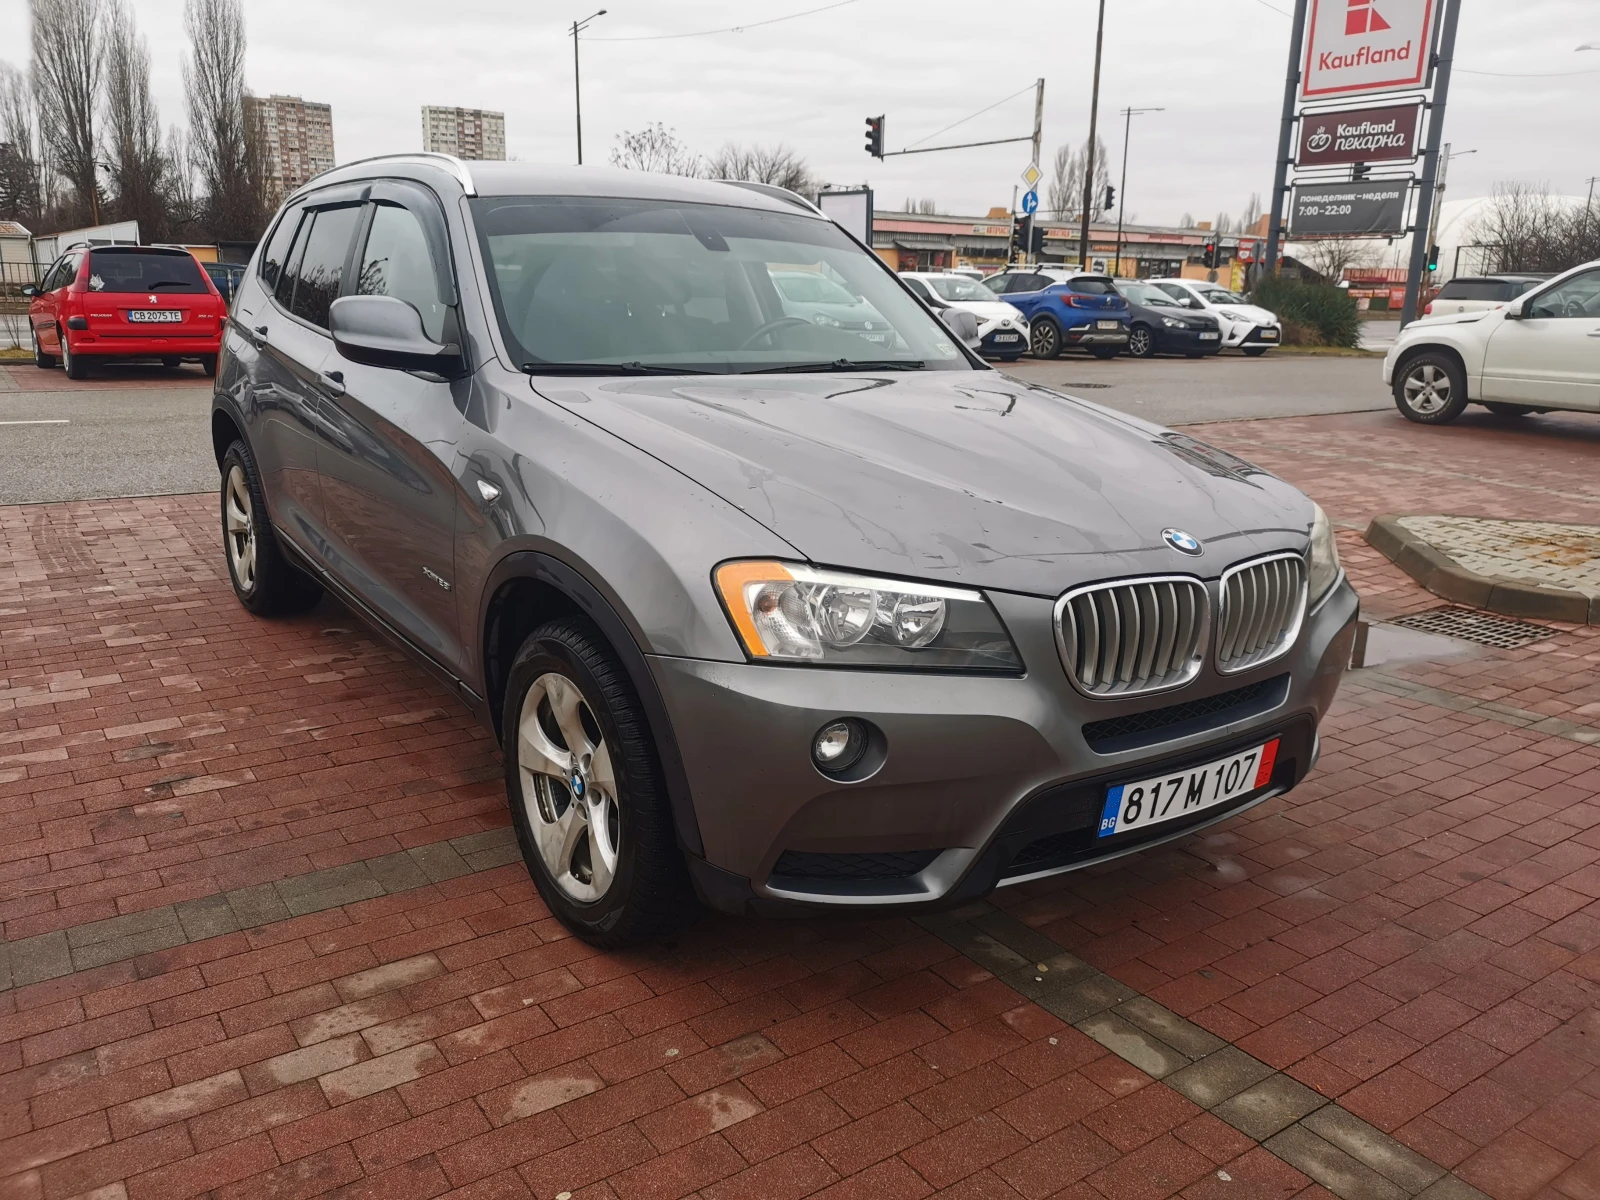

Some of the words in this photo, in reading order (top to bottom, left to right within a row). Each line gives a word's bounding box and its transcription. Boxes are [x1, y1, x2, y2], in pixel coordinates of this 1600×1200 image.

[1319, 40, 1411, 71] Kaufland
[1336, 119, 1396, 137] Kaufland
[1334, 133, 1406, 152] пекарна
[133, 311, 146, 320] CB
[146, 311, 168, 320] 2075
[168, 311, 181, 320] TE
[1122, 776, 1184, 825] 817
[1183, 769, 1208, 810] M
[1213, 752, 1258, 800] 107
[1100, 816, 1116, 830] BG
